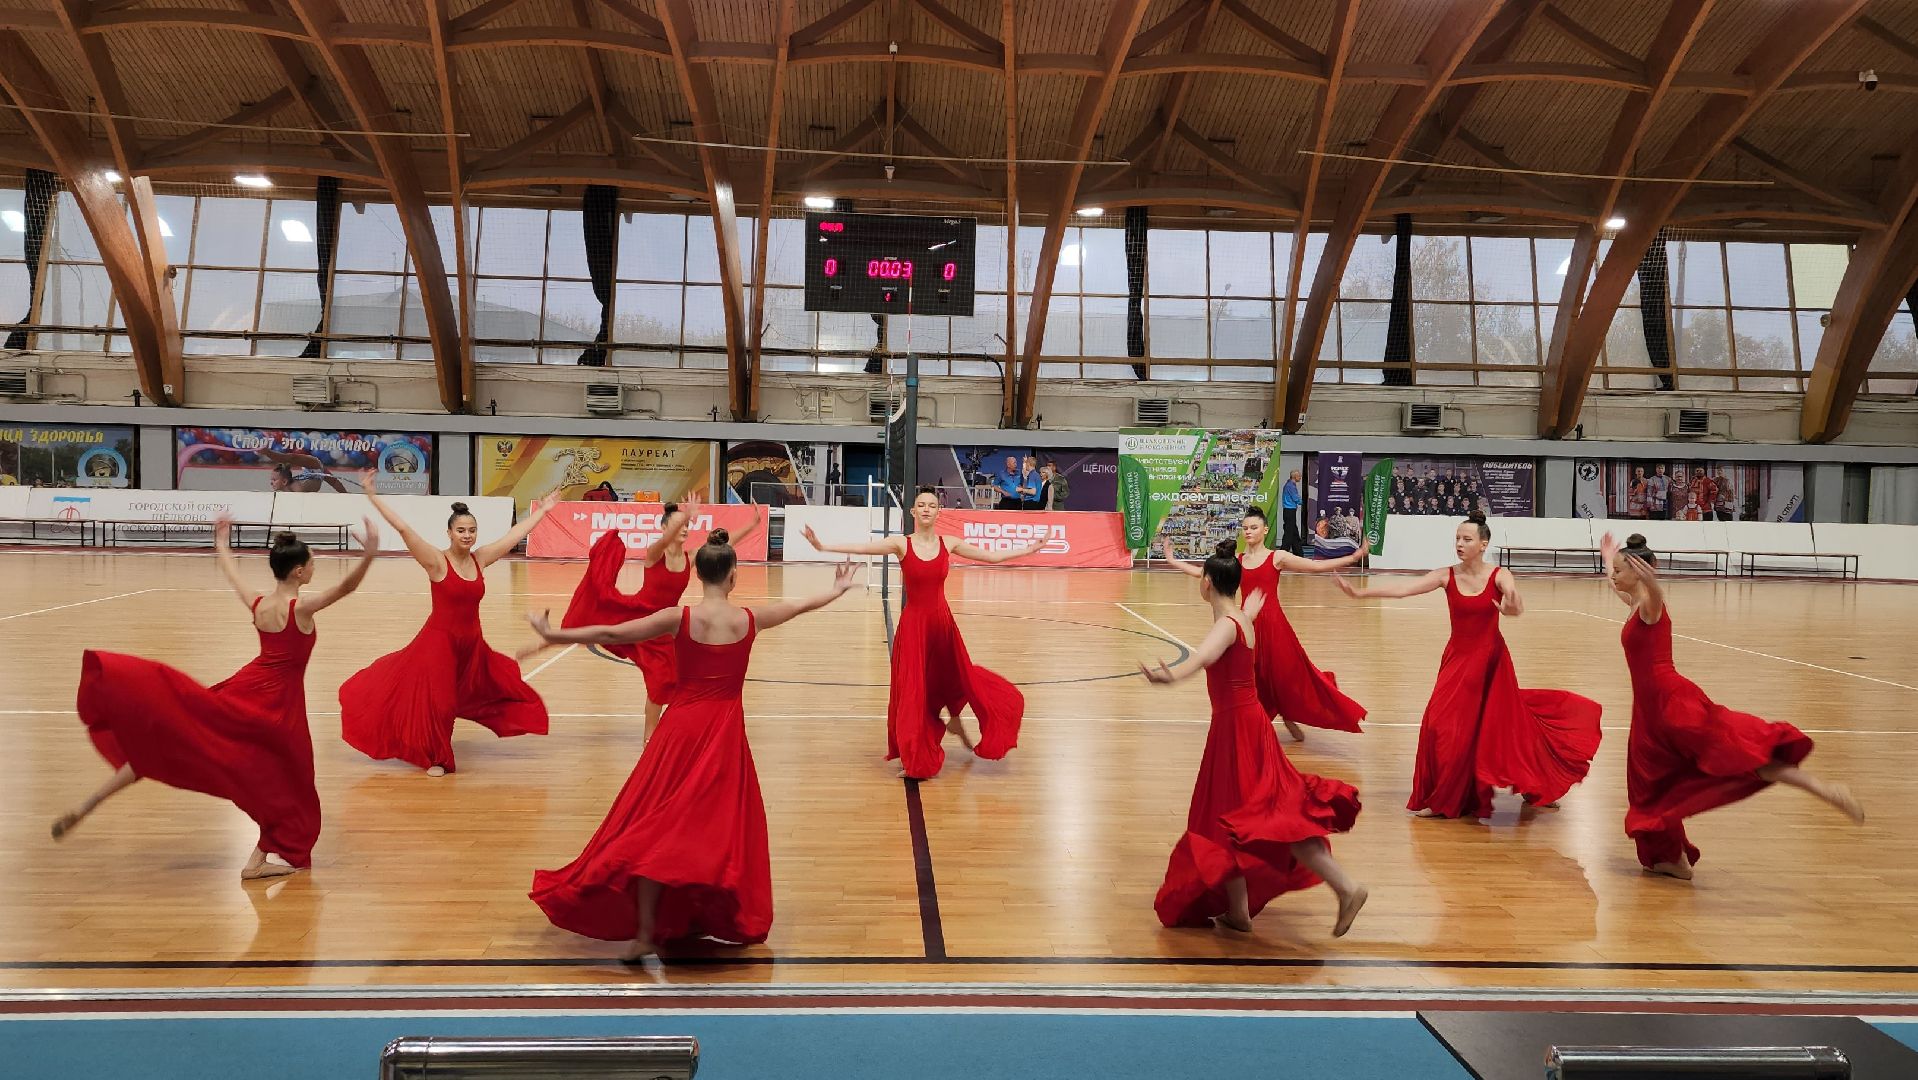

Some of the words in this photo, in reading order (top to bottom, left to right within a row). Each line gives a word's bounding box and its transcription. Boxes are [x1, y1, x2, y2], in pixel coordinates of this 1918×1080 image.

[824, 259, 837, 275] 0
[944, 263, 956, 279] 0
[622, 448, 676, 458] ЛАУРЕАТ
[128, 501, 195, 511] ГОРОДСКОЙ
[197, 503, 232, 511] ОКРУГ
[963, 522, 1066, 539] МОСОБЛ
